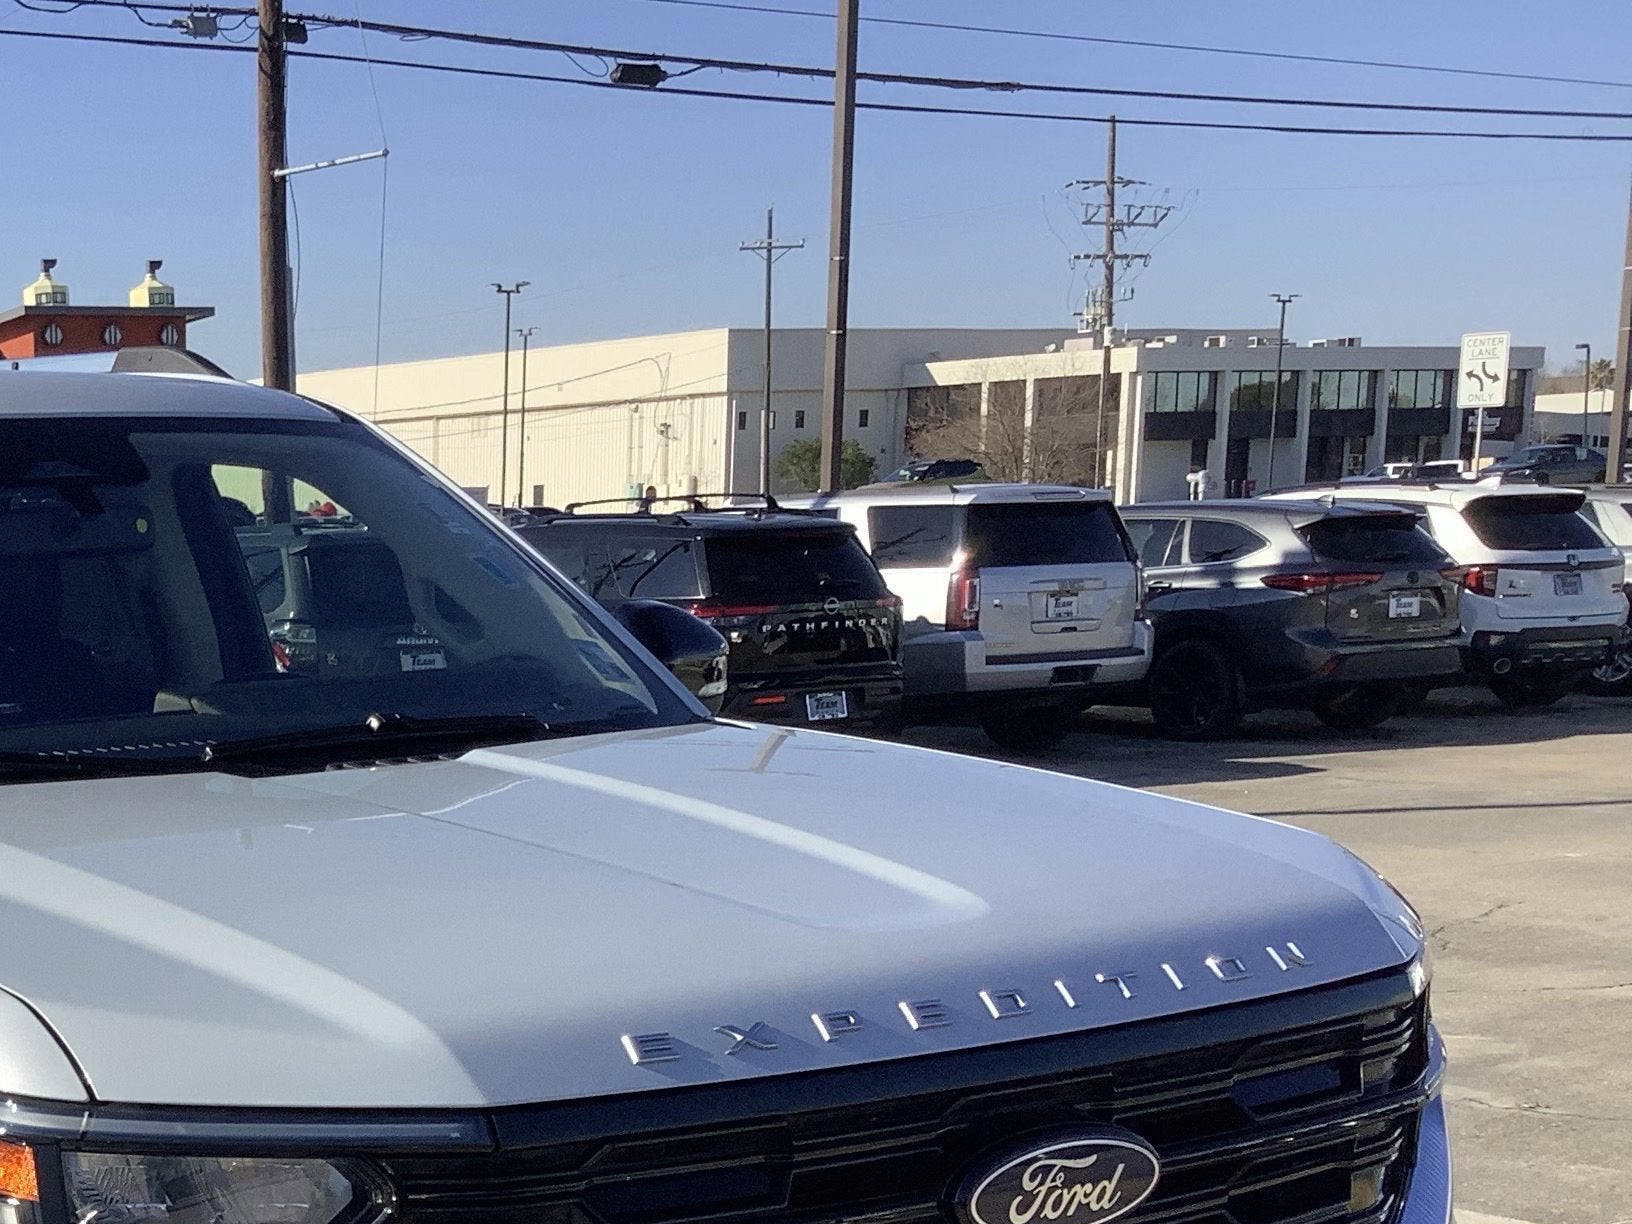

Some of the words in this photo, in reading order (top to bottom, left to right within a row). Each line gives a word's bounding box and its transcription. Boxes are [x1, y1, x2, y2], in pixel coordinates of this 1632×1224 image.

[1466, 336, 1505, 348] CENTER
[1471, 346, 1498, 358] LANE
[1468, 392, 1495, 403] ONLY
[761, 617, 888, 633] PATHFINDER
[620, 941, 1313, 1066] EXPEDITION
